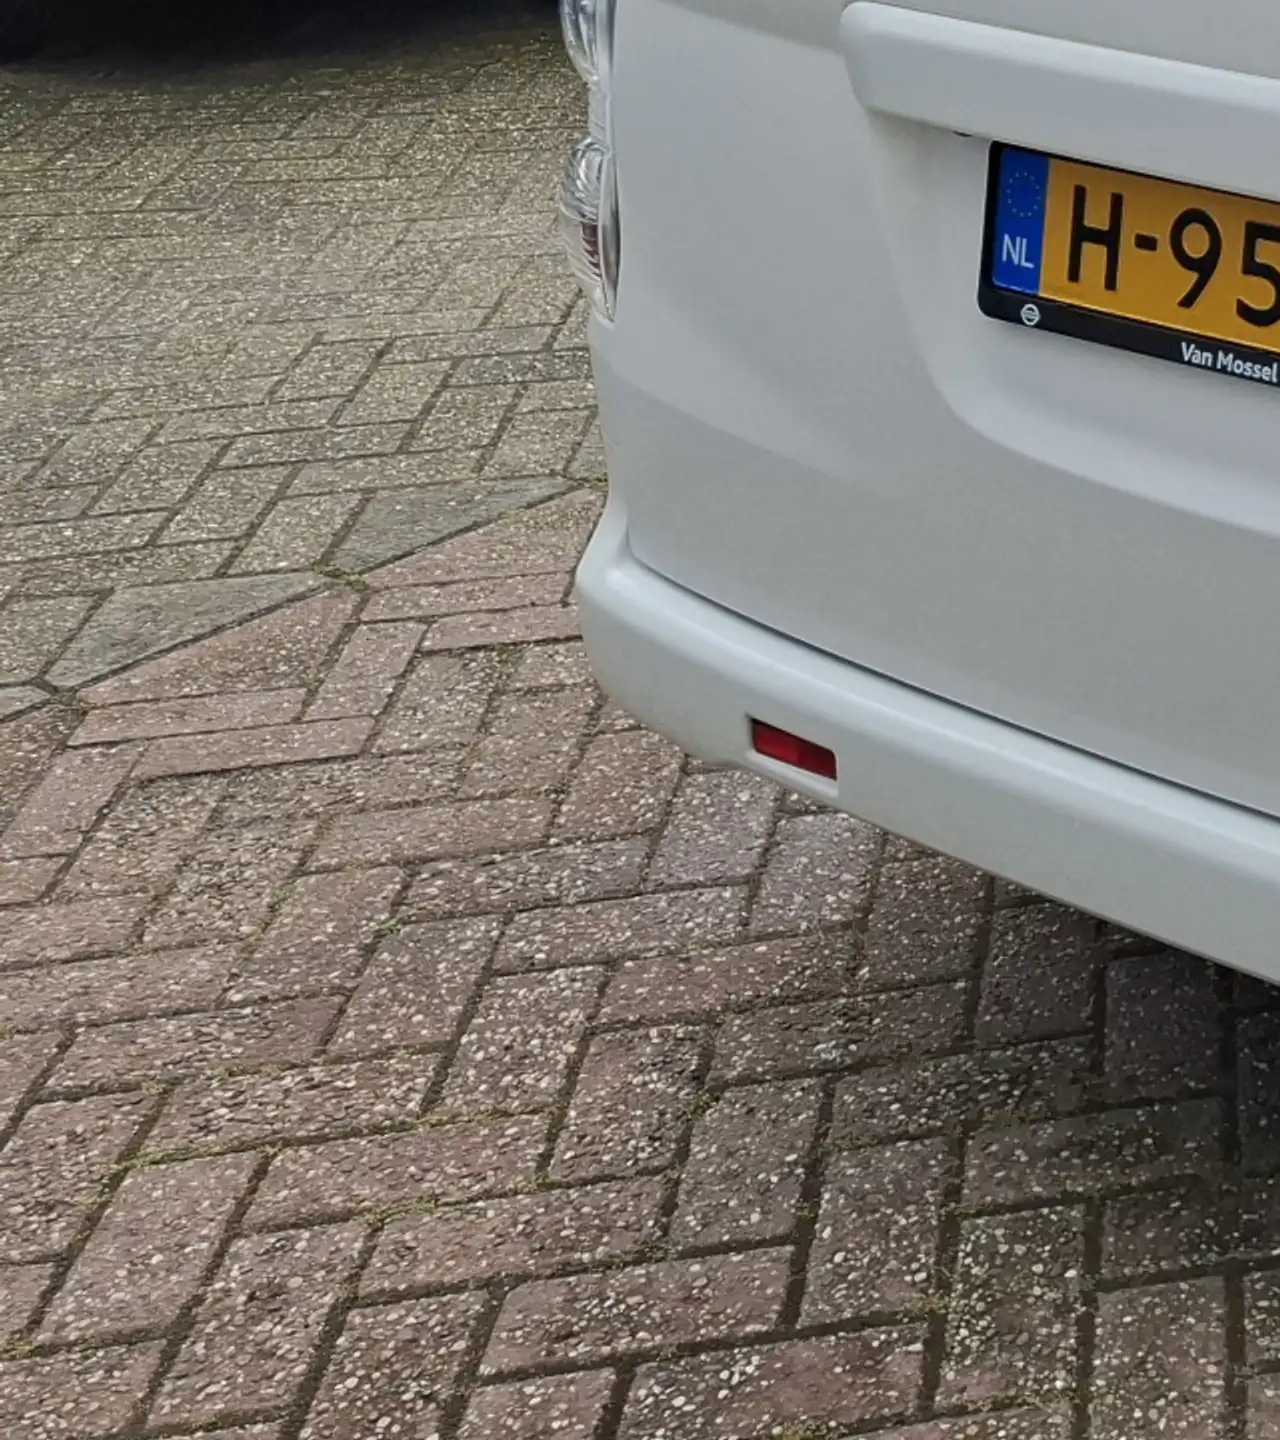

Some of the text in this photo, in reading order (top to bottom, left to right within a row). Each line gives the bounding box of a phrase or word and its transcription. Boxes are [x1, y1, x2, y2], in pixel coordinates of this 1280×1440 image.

[1001, 233, 1035, 270] NL
[1181, 341, 1213, 368] Van
[1216, 350, 1279, 384] Mossel
